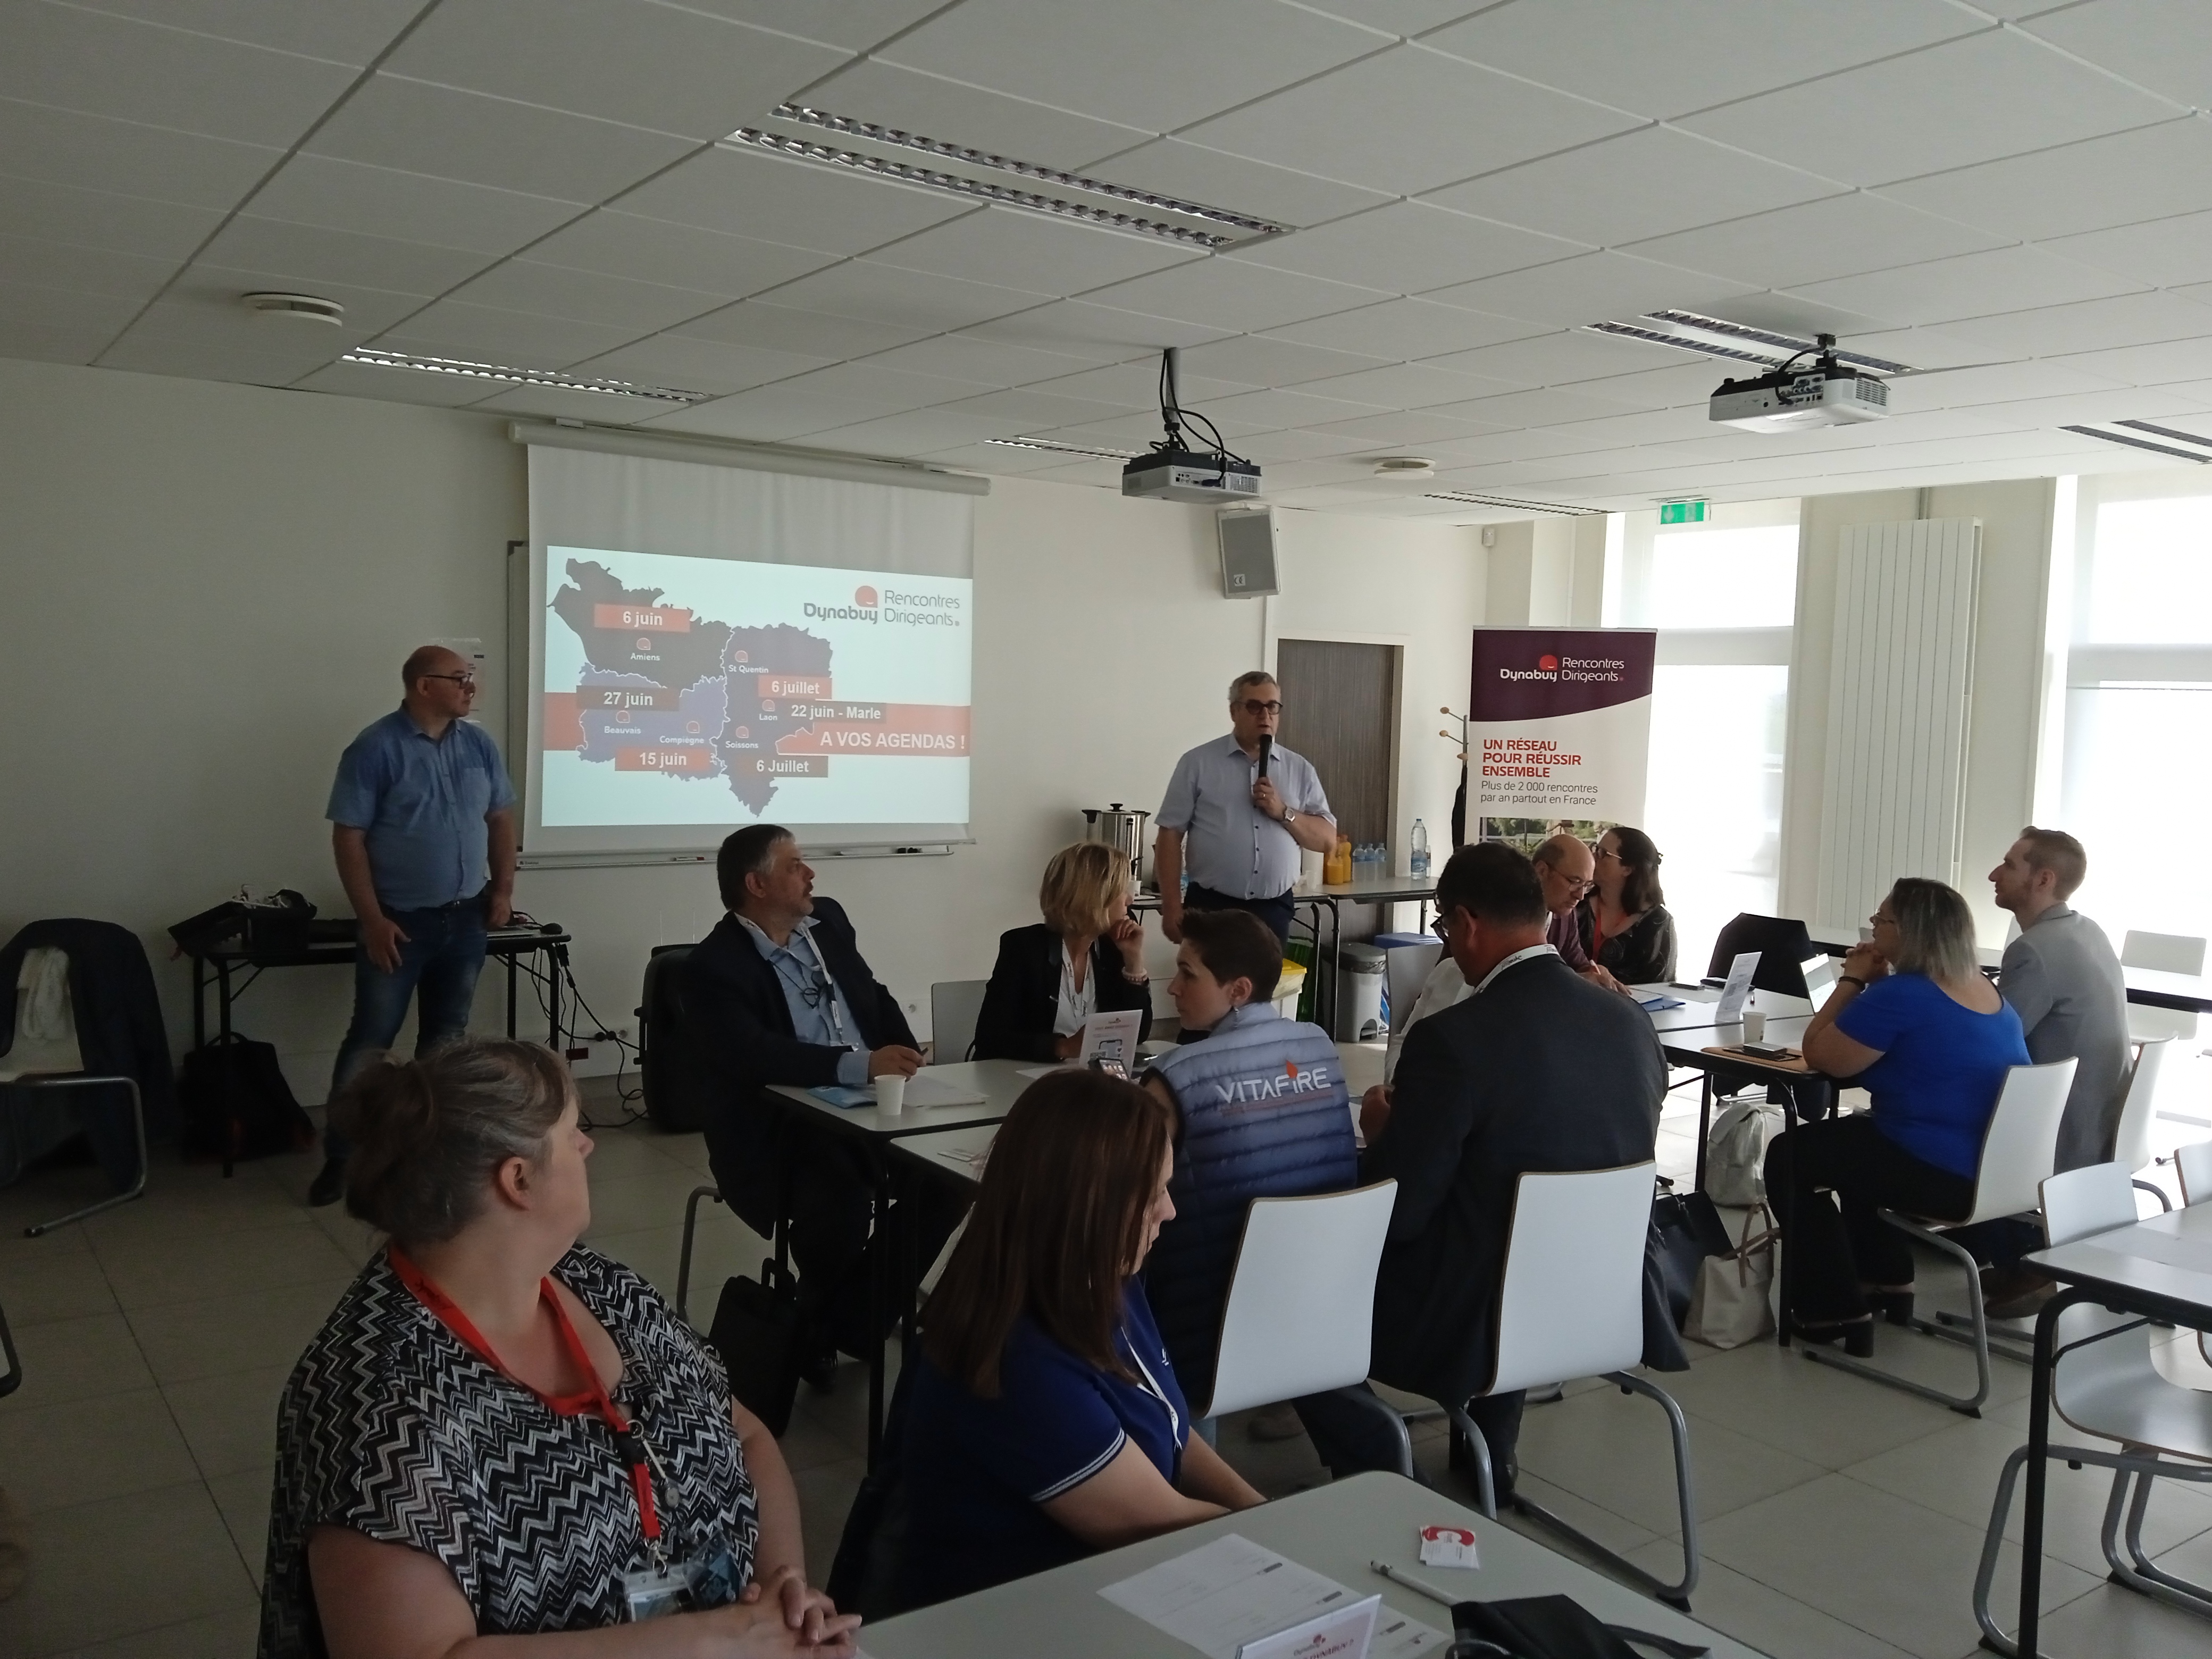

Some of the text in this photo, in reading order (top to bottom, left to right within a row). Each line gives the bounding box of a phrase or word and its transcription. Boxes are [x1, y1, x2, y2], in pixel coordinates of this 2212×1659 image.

[884, 590, 960, 609] Rencontres
[623, 610, 663, 627] 6 juin
[803, 602, 878, 624] Dynabuy
[630, 652, 660, 661] Amiens
[1562, 657, 1625, 669] Rencontres
[739, 665, 769, 674] Quentin
[1499, 668, 1557, 683] Dynabuy
[771, 681, 820, 696] 6 juillet
[604, 692, 653, 708] 27 juin
[791, 705, 807, 717] 22
[809, 705, 834, 720] juin
[846, 706, 881, 719] Marle
[604, 725, 642, 734] Beauvais
[659, 735, 705, 746] Compiègne
[725, 741, 759, 749] Soissons
[819, 731, 966, 749] A VOS AGENDAS !
[1483, 737, 1557, 751] UN RÉSEAU
[639, 752, 687, 768] 15 juin
[1482, 751, 1582, 766] POUR RÉUSSIR
[756, 760, 809, 773] 6 Juillet
[1482, 765, 1551, 778] ENSEMBLE
[1481, 780, 1598, 793] Plus de 2 000 rencontres
[1480, 794, 1496, 803] par
[1512, 795, 1547, 804] partout
[1563, 795, 1597, 806] France
